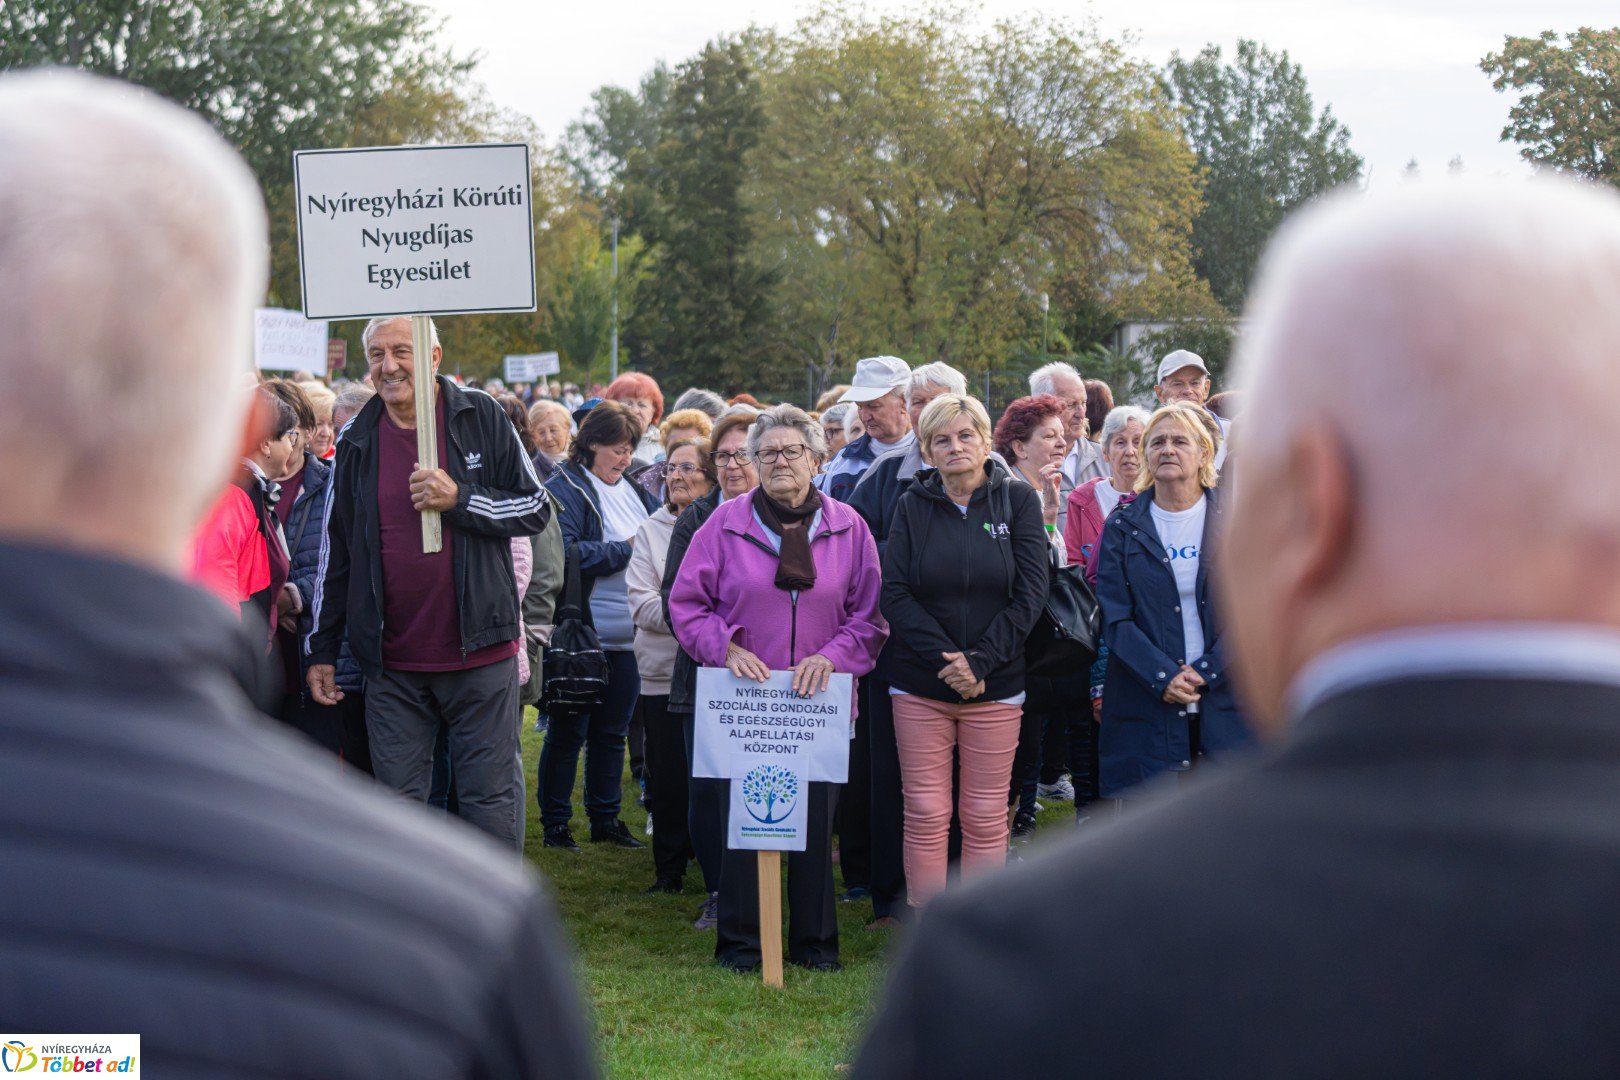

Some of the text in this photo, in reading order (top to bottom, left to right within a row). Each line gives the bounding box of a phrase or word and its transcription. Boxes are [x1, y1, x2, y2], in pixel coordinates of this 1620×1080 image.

[308, 184, 522, 219] Nyíregyházi Körúti
[362, 223, 474, 253] Nyugdíjas
[367, 258, 471, 289] Egyesület
[708, 700, 838, 715] SZOCIÁLIS GONDOZÁSI
[719, 714, 826, 728] ÉS EGÉSZSÉGÜGYI
[729, 729, 815, 741] ALAPELLÁTÁSI
[744, 743, 799, 754] KÖZPONT
